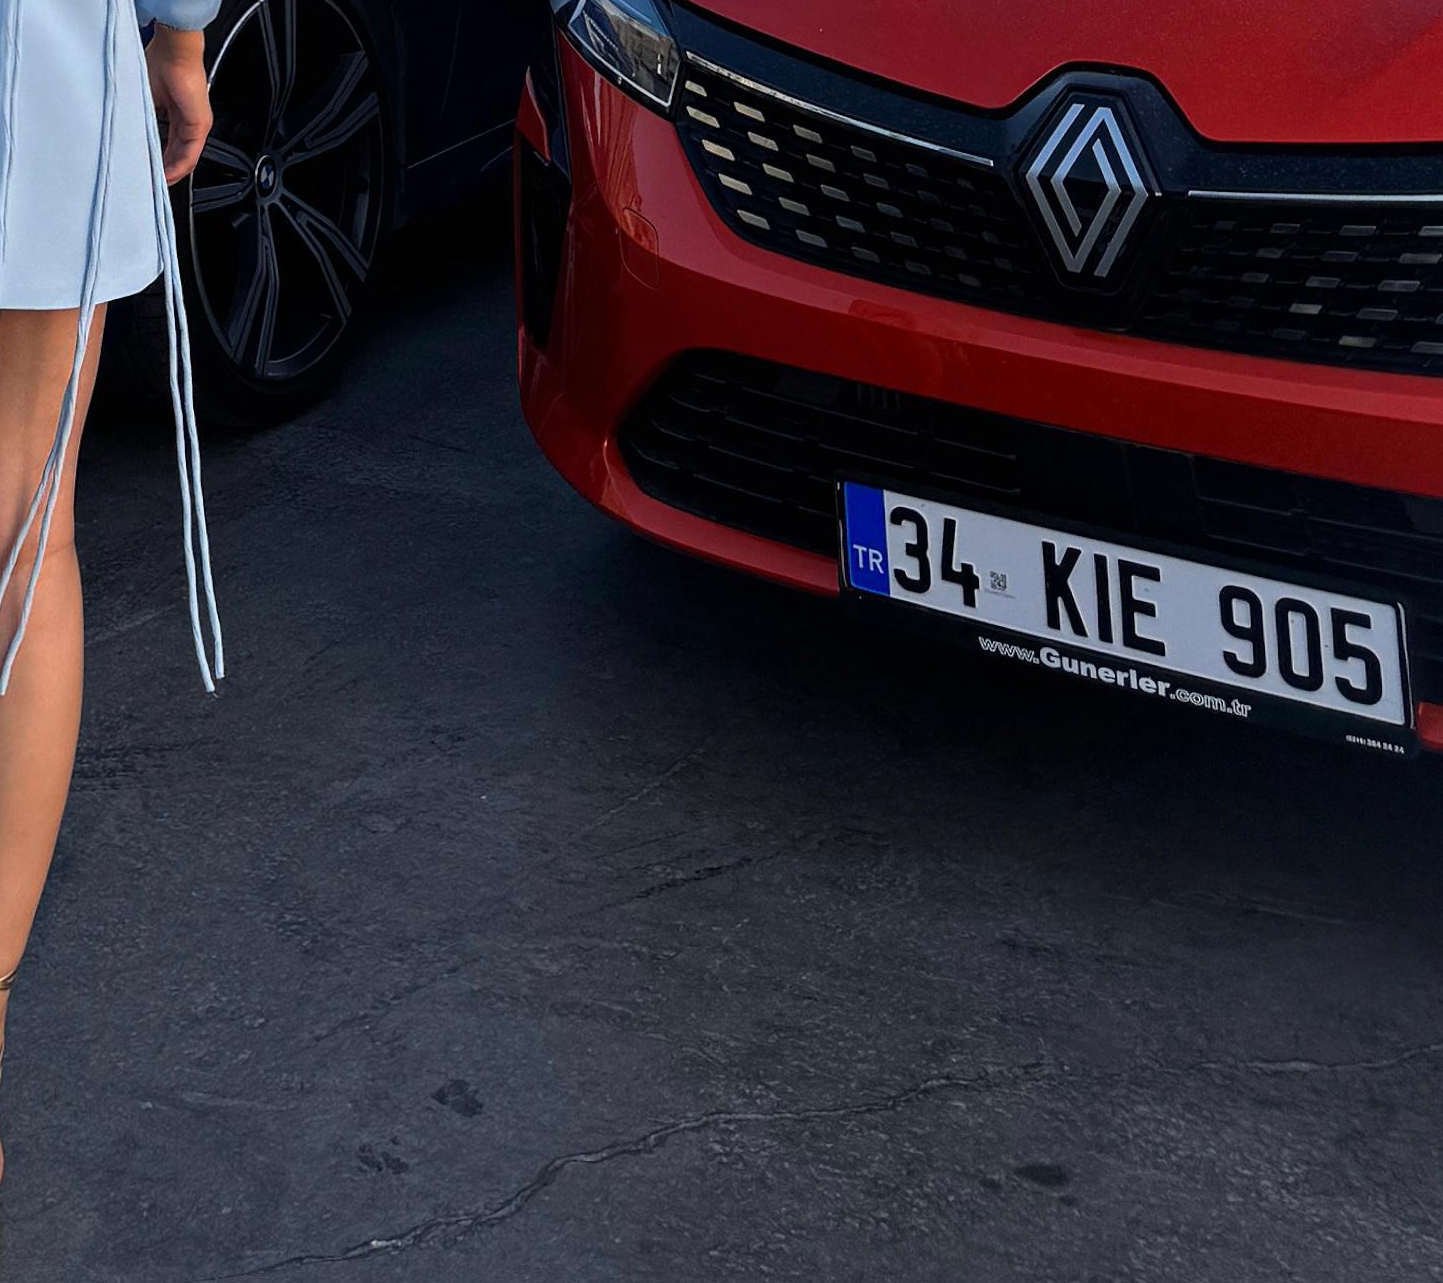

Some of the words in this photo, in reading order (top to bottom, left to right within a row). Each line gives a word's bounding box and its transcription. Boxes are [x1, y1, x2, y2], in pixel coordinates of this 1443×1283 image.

[853, 543, 884, 575] TR
[890, 506, 980, 608] 34
[1042, 541, 1166, 657] KIE
[1220, 585, 1384, 706] 905
[978, 636, 1252, 717] www.Gunerler.com.tr
